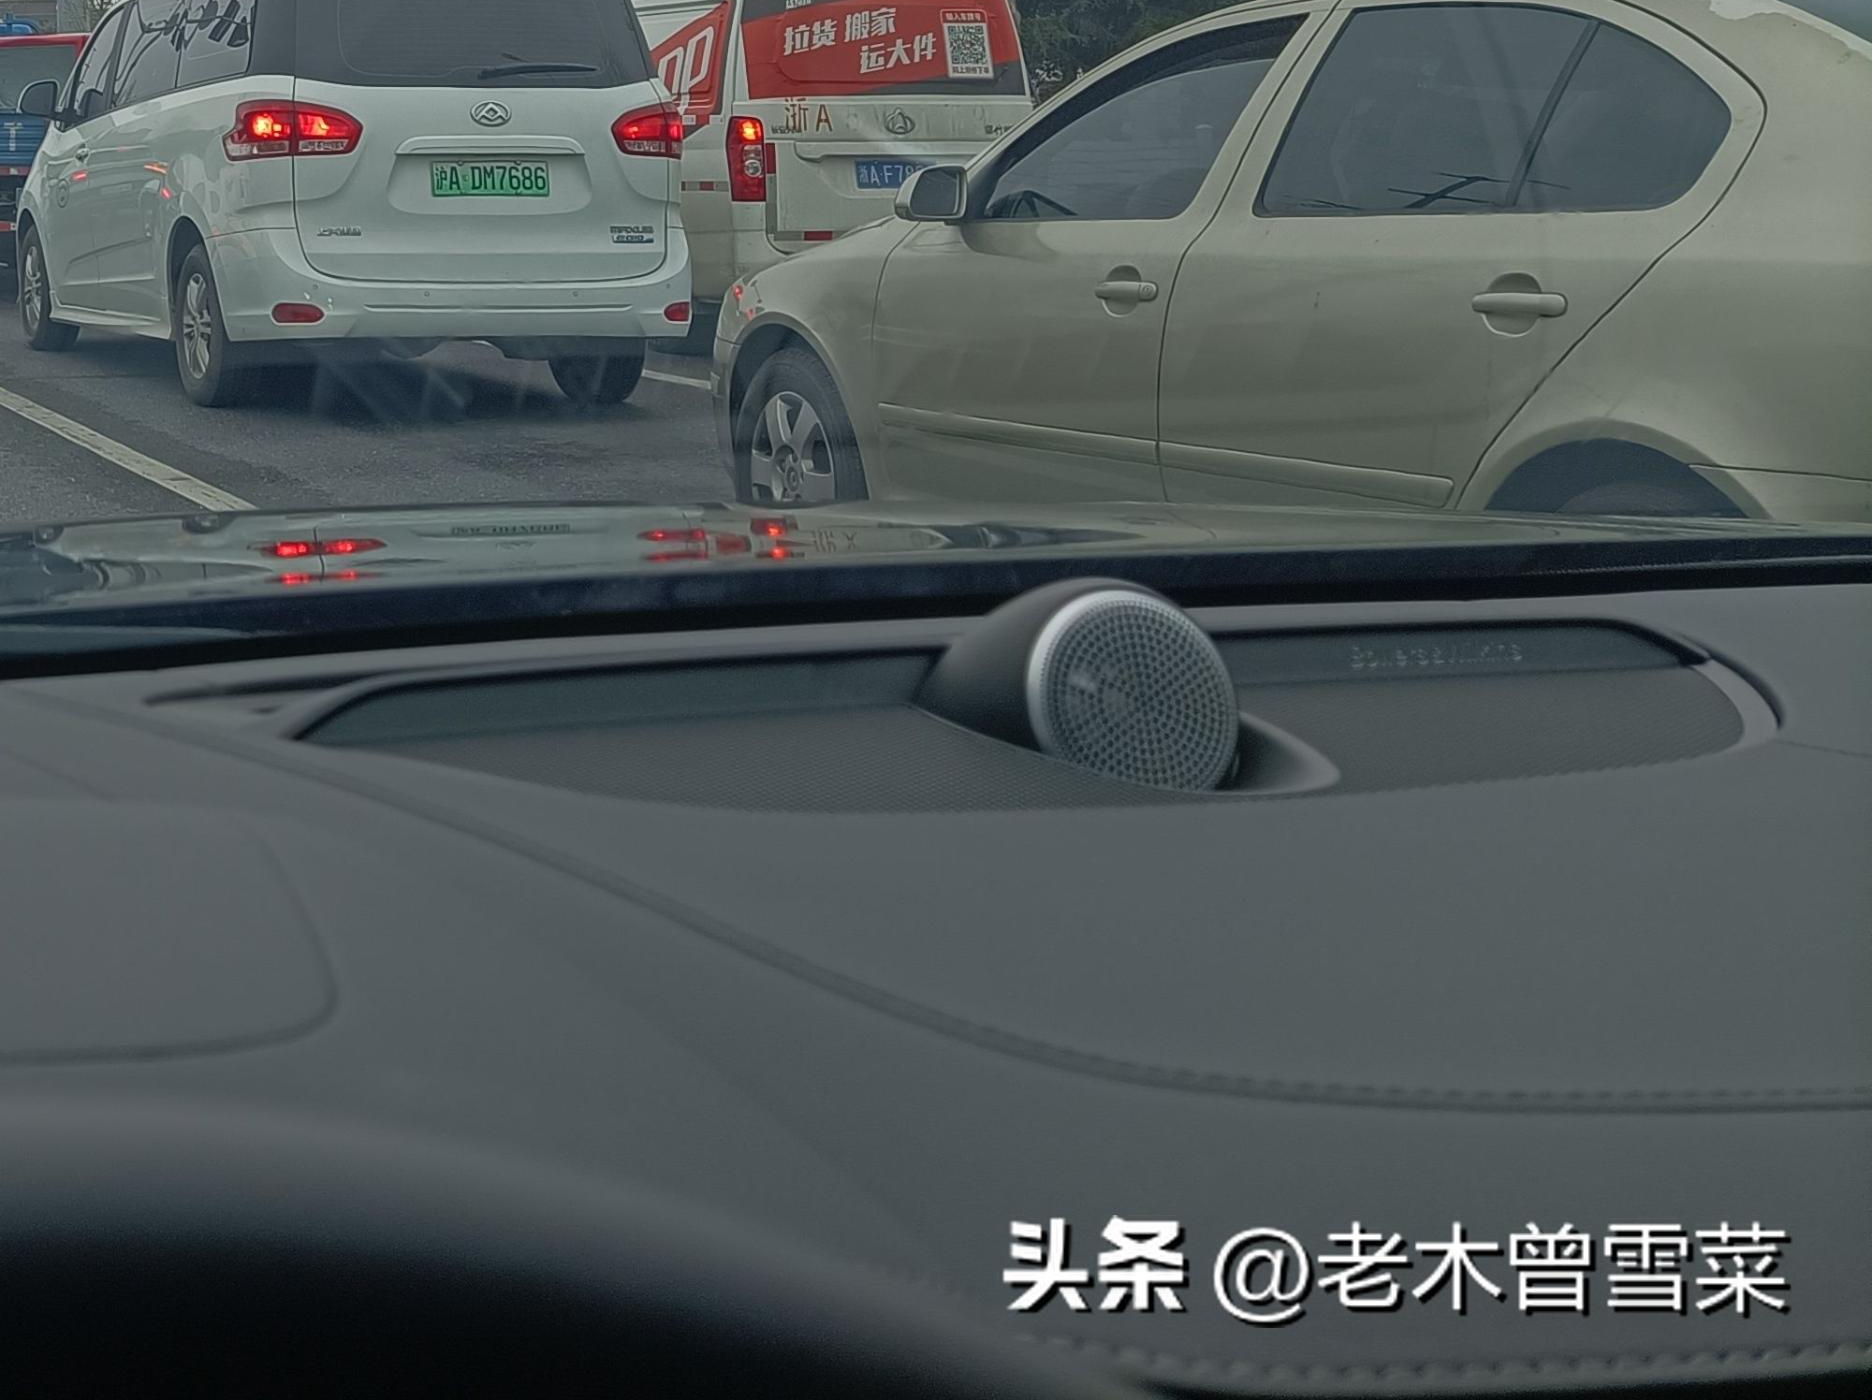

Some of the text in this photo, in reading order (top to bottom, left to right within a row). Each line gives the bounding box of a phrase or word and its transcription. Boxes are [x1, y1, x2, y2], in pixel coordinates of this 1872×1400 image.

[783, 7, 897, 56] 拉货 搬家
[859, 32, 937, 74] 运大件
